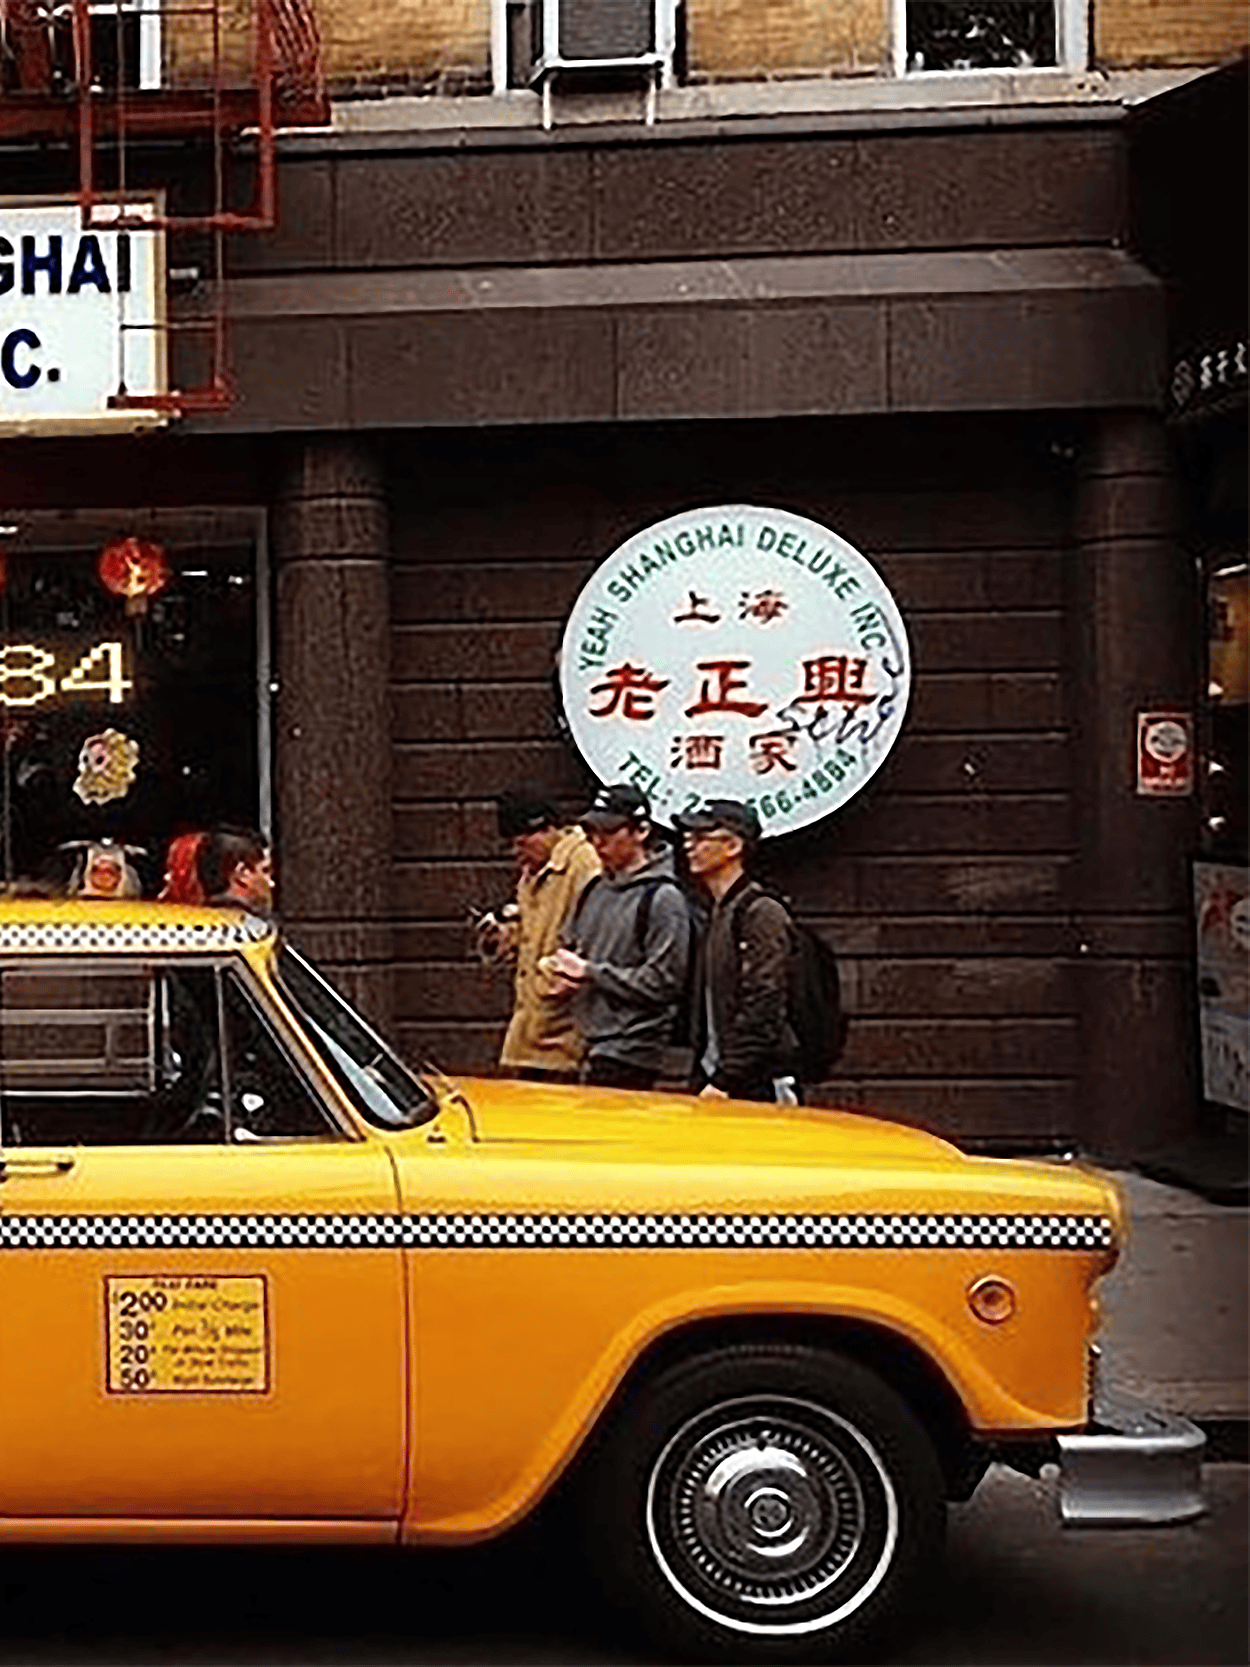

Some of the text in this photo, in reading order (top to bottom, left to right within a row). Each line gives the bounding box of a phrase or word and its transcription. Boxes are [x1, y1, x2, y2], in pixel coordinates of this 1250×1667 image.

[578, 606, 618, 672] YEAH
[606, 523, 745, 603] SHANGHAI
[756, 526, 862, 601] DELUXE
[673, 589, 790, 625] 上海
[588, 655, 880, 719] 老正興
[618, 750, 673, 806] TEL:
[670, 733, 797, 774] 酒家
